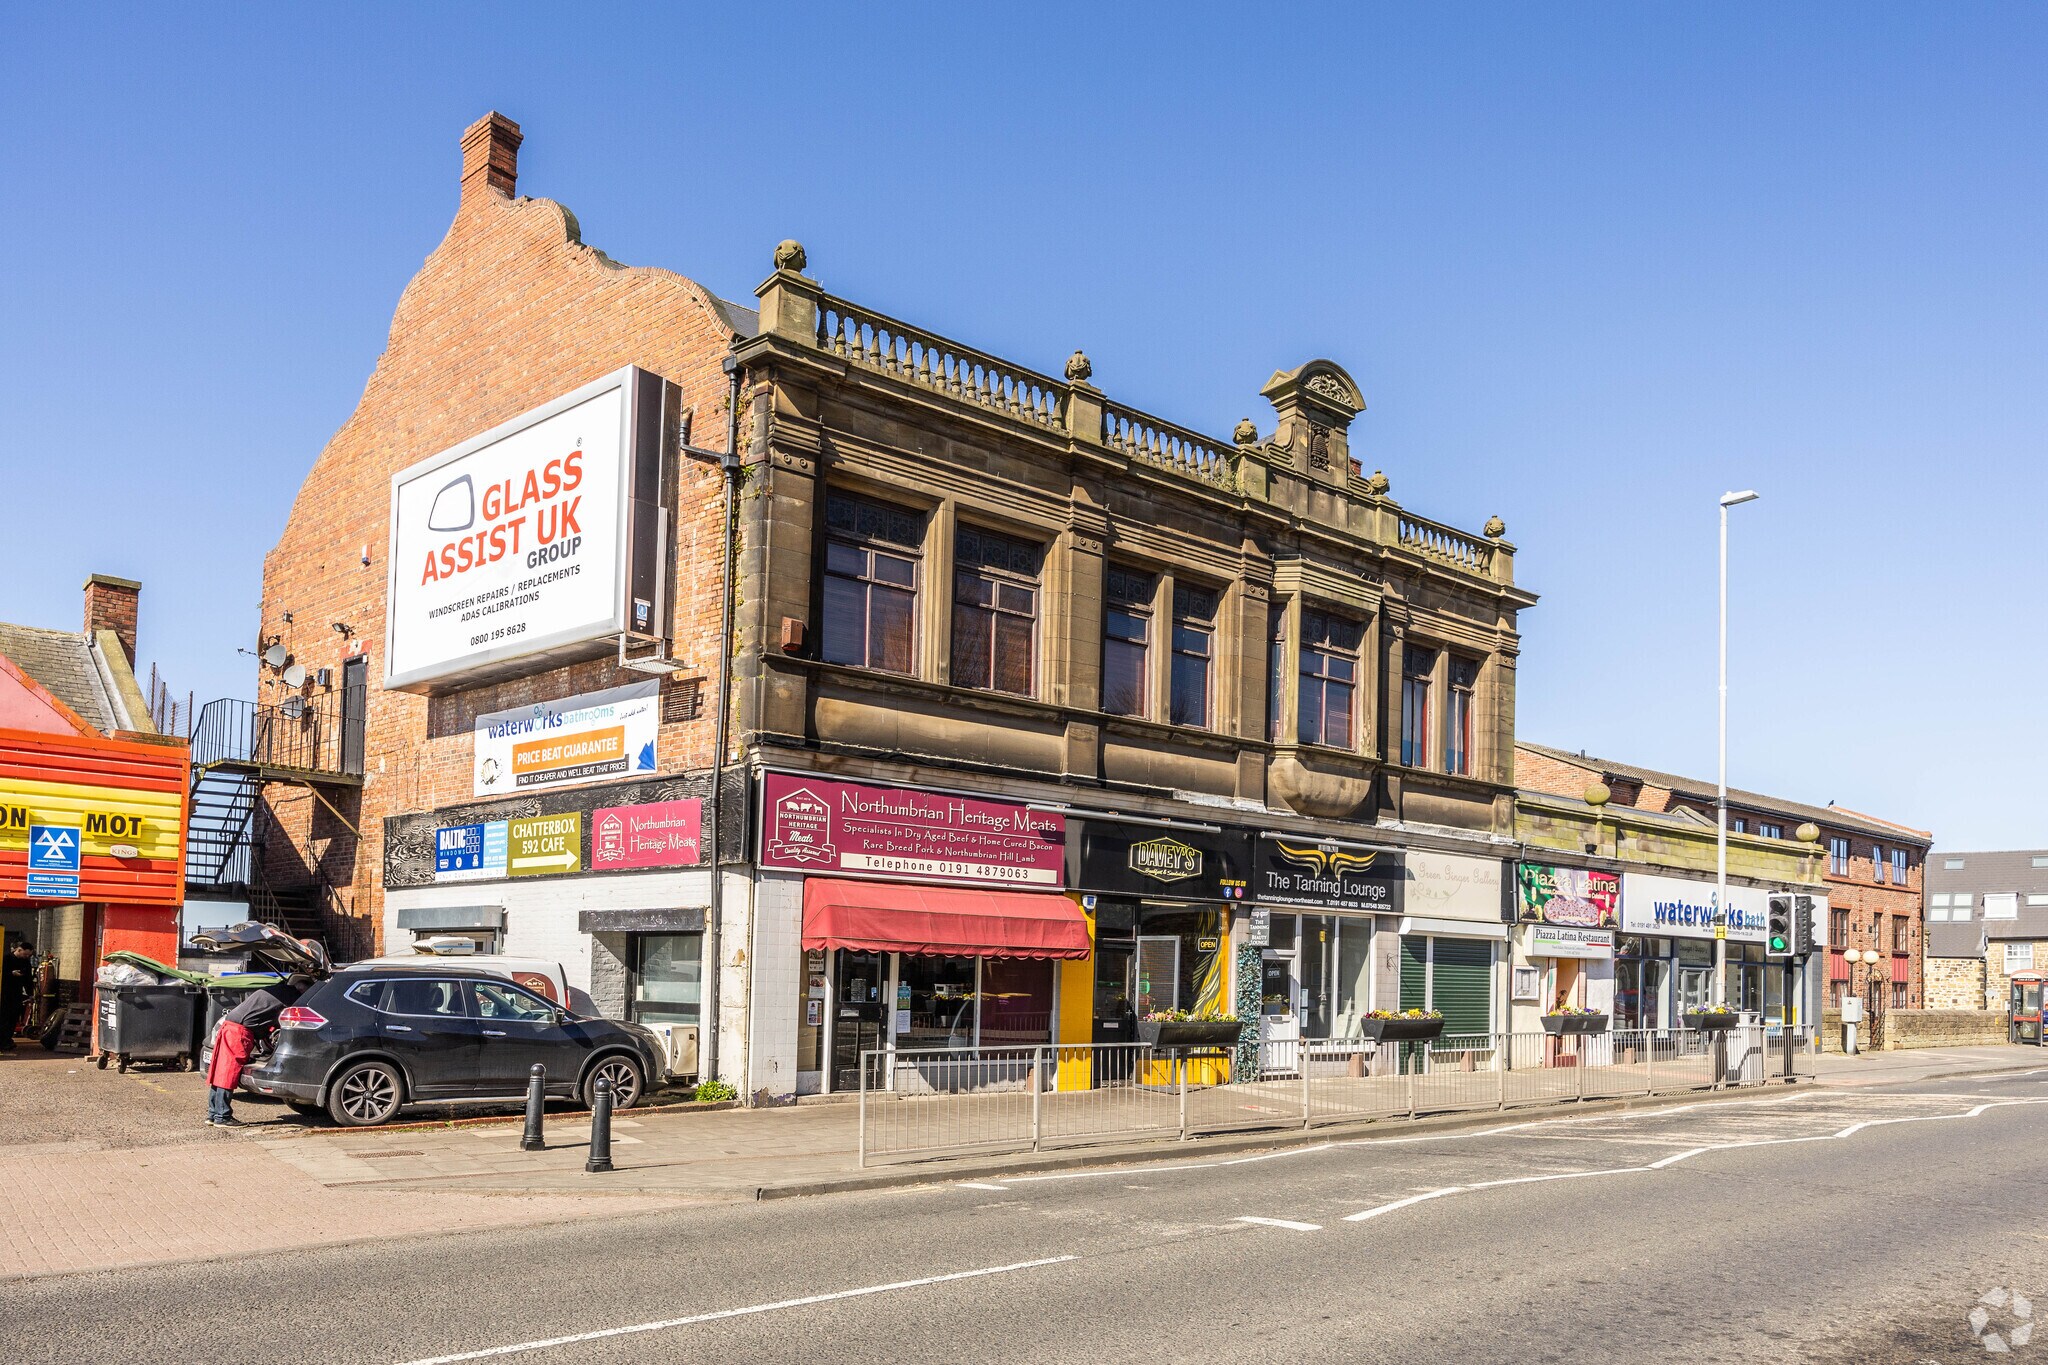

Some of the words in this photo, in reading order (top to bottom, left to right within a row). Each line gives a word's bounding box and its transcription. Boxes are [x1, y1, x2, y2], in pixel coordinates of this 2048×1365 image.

[482, 451, 582, 521] GLASS
[421, 516, 526, 586] ASSIST
[537, 495, 582, 545] UK
[527, 536, 582, 569] GROUP
[428, 597, 475, 619] WINDSCREEN
[476, 586, 509, 605] REPAIRS
[511, 584, 515, 595] /
[518, 564, 580, 592] REPLACEMENTS
[461, 608, 480, 622] ADAS
[482, 591, 540, 616] CALIBRATIONS
[470, 633, 488, 646] 0800
[491, 628, 504, 640] 195
[506, 622, 526, 636] 8628
[488, 711, 563, 739] waterworks
[517, 751, 540, 766] PRICE
[541, 746, 563, 762] BEAT
[563, 737, 618, 759] GUARANTEE
[518, 776, 529, 784] FIND
[534, 772, 556, 782] CHEAPER
[557, 770, 567, 779] AND
[582, 766, 596, 775] BEAT
[596, 764, 609, 773] THAT
[609, 761, 626, 771] PRICE!
[779, 813, 827, 823] NORTHUMBRIAN
[841, 790, 944, 820] Northumbrian
[948, 802, 1010, 832] Heritage
[1014, 809, 1057, 832] Meats
[85, 813, 142, 836] MOT
[513, 818, 575, 839] CHATTERBOX
[630, 814, 686, 833] Northumbrian
[788, 821, 818, 830] HERITAGE
[440, 828, 466, 850] BALTIC
[522, 840, 538, 854] 592
[541, 837, 565, 853] CAFE
[630, 835, 667, 853] Heritage
[668, 833, 696, 850] Meats
[789, 830, 814, 843] Meats
[843, 822, 892, 835] Specialists
[894, 827, 902, 837] In
[905, 828, 921, 840] Dry
[924, 831, 946, 842] Aged
[949, 833, 969, 843] Beef
[979, 836, 1001, 846] Home
[1003, 838, 1027, 848] Cured
[1029, 841, 1053, 851] Bacon
[112, 848, 137, 856] KINGS
[863, 839, 883, 849] Rare
[886, 841, 912, 851] Breed
[915, 844, 934, 853] Pork
[945, 847, 997, 859] Northumbrian
[999, 851, 1014, 861] Hill
[1016, 853, 1035, 863] Lamb
[1138, 841, 1195, 870] DAVEY'S
[865, 857, 933, 871] Telephone
[939, 862, 969, 874] 0191
[976, 866, 1028, 879] 4879063
[1418, 861, 1441, 880] Green
[1444, 865, 1470, 884] Ginger
[1473, 867, 1500, 891] Gallery
[1219, 878, 1234, 886] FOLLOW
[1266, 871, 1290, 889] The
[1293, 874, 1341, 898] Tanning
[1344, 880, 1386, 901] Lounge
[1525, 869, 1572, 887] Piazza
[1577, 875, 1617, 893] Latina
[1654, 899, 1743, 927] waterwks
[1535, 929, 1555, 939] Piazza
[1557, 930, 1576, 941] Latina
[1577, 932, 1610, 943] Restaurant
[1716, 927, 1725, 937] H
